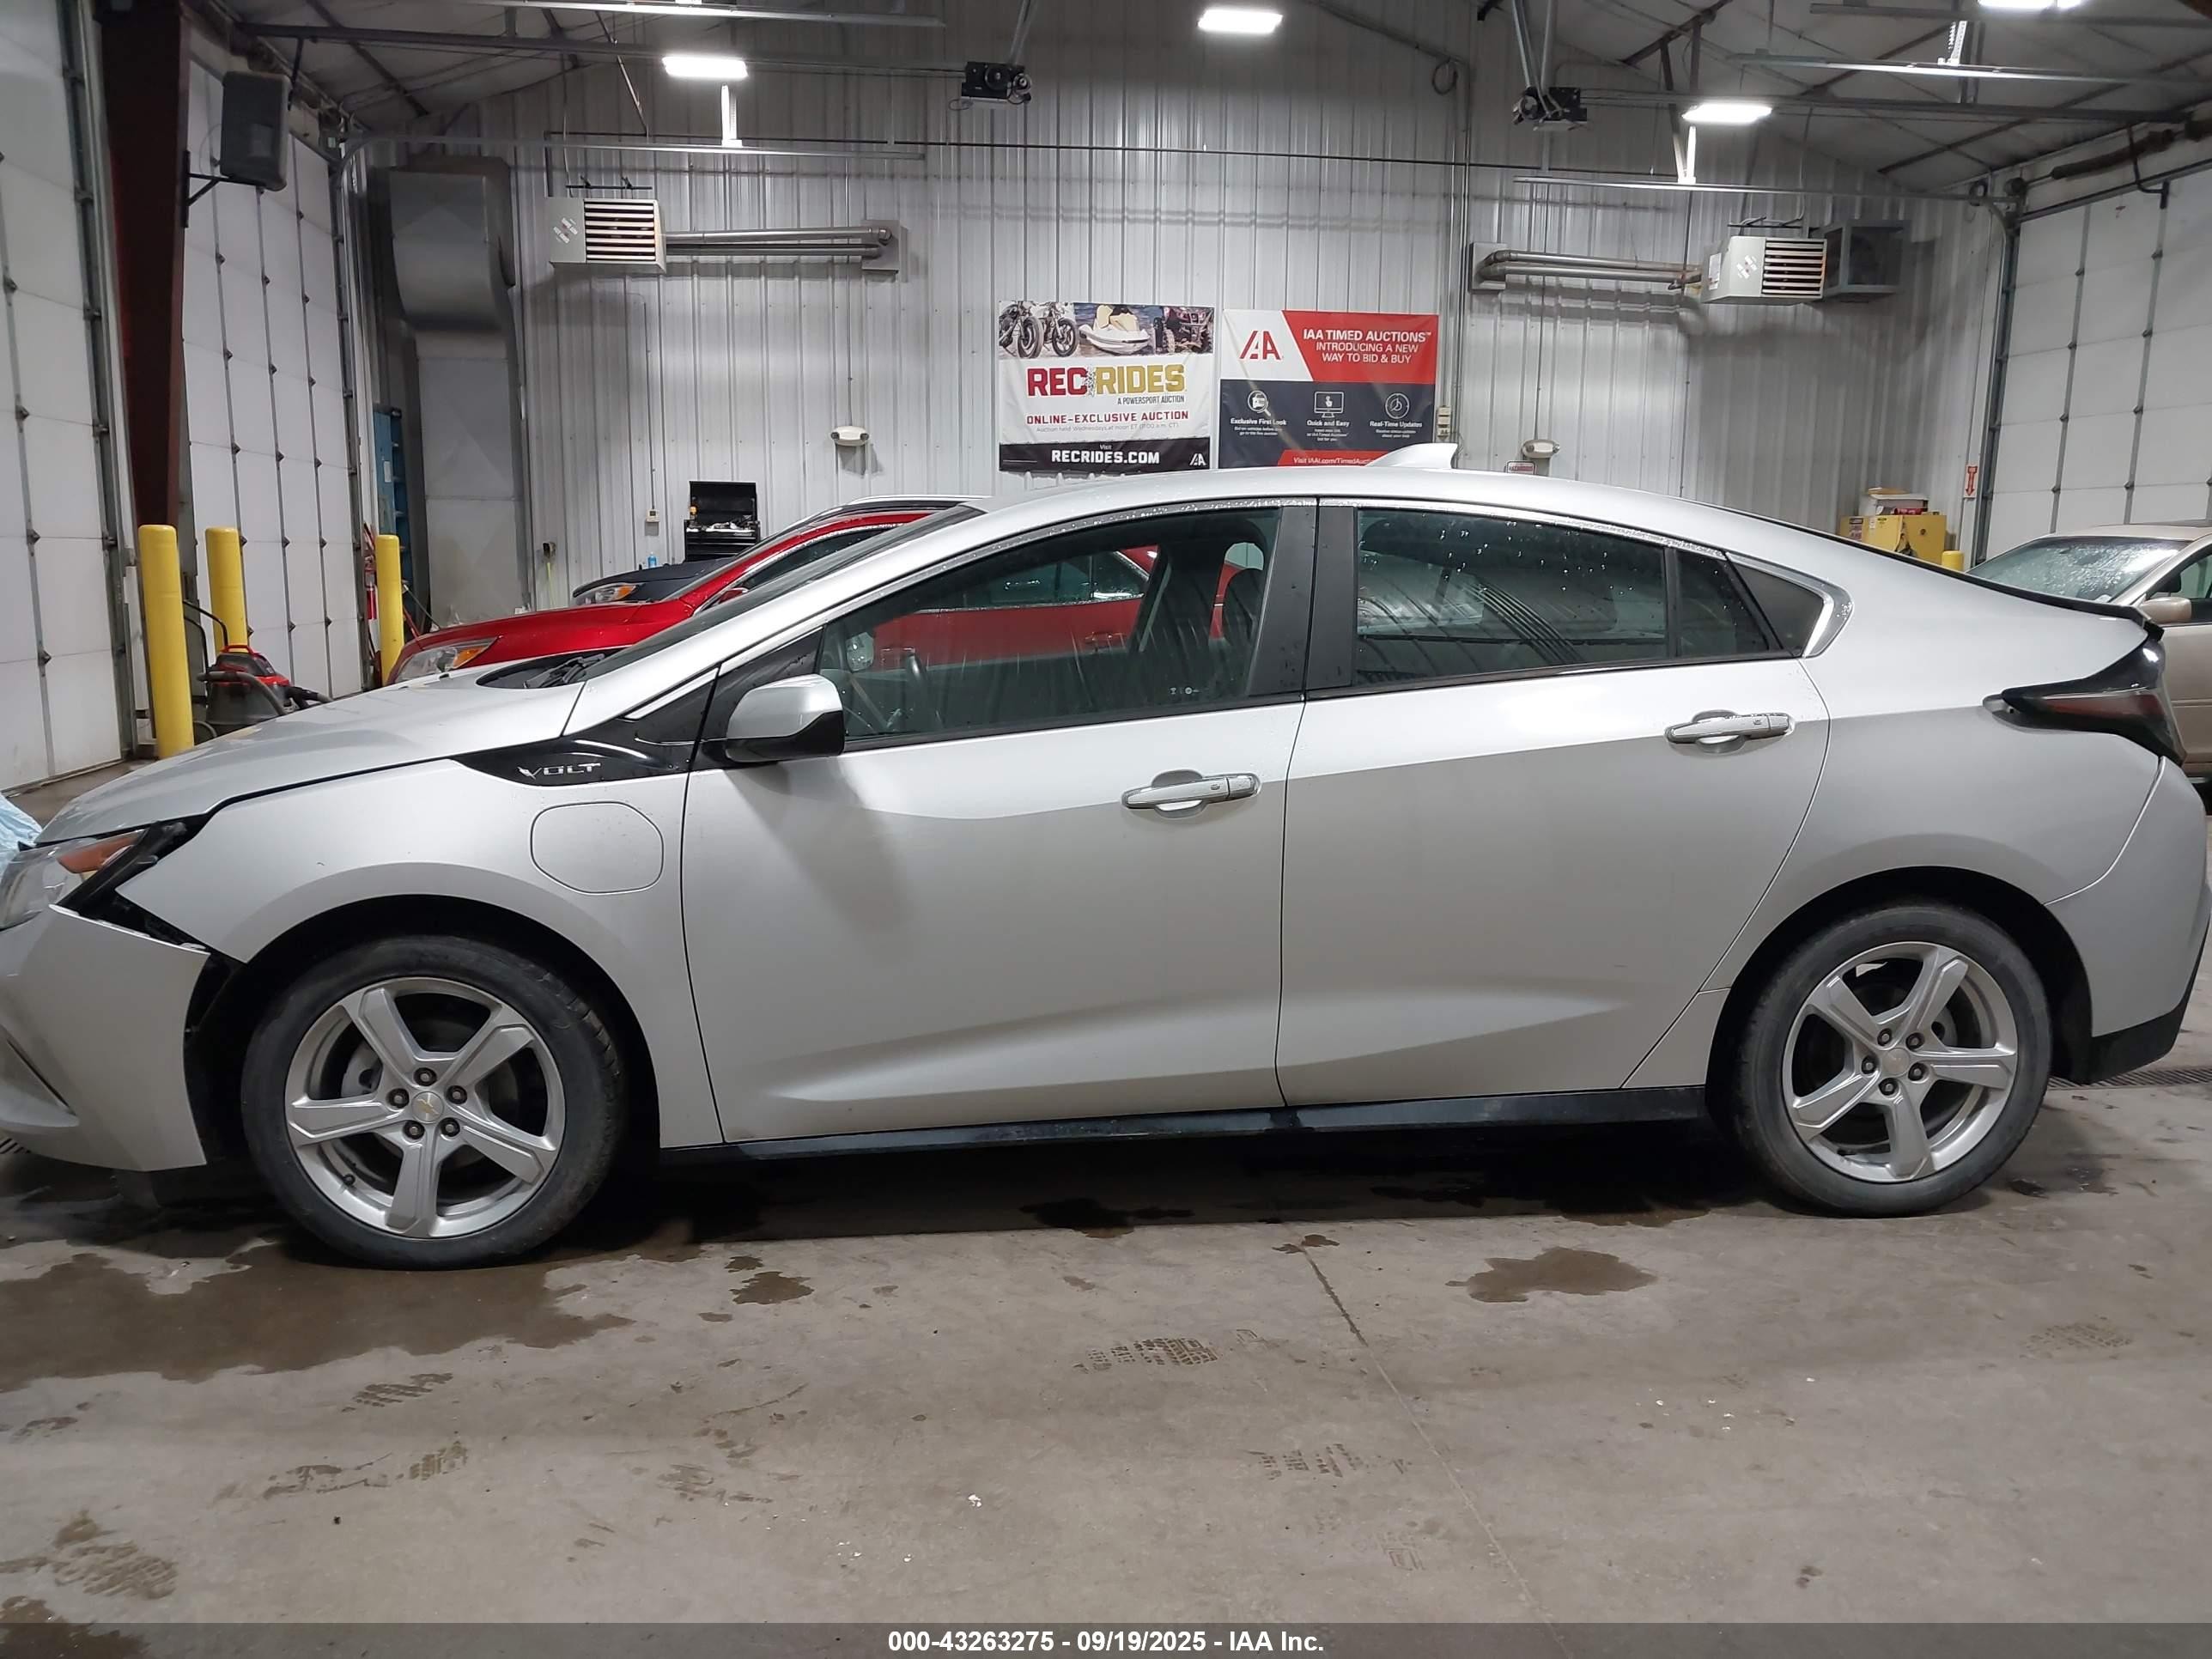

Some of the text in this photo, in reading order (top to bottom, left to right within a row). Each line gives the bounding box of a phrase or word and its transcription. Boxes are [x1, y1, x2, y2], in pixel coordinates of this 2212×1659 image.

[1304, 329, 1323, 339] IAA
[1326, 330, 1363, 341] TIMED
[1316, 342, 1382, 352] INTRODUCING
[1395, 344, 1419, 353] NEW
[1322, 353, 1344, 362] WAY
[1346, 354, 1360, 362] TO
[1363, 354, 1378, 362] BID
[1391, 355, 1412, 363] BUY
[1027, 364, 1186, 396] REC RIDES
[1027, 411, 1188, 424] ONLINE-EXCLUSIVE AUCTION
[1052, 450, 1159, 464] RECRIDES.COM
[518, 763, 601, 780] VOLT
